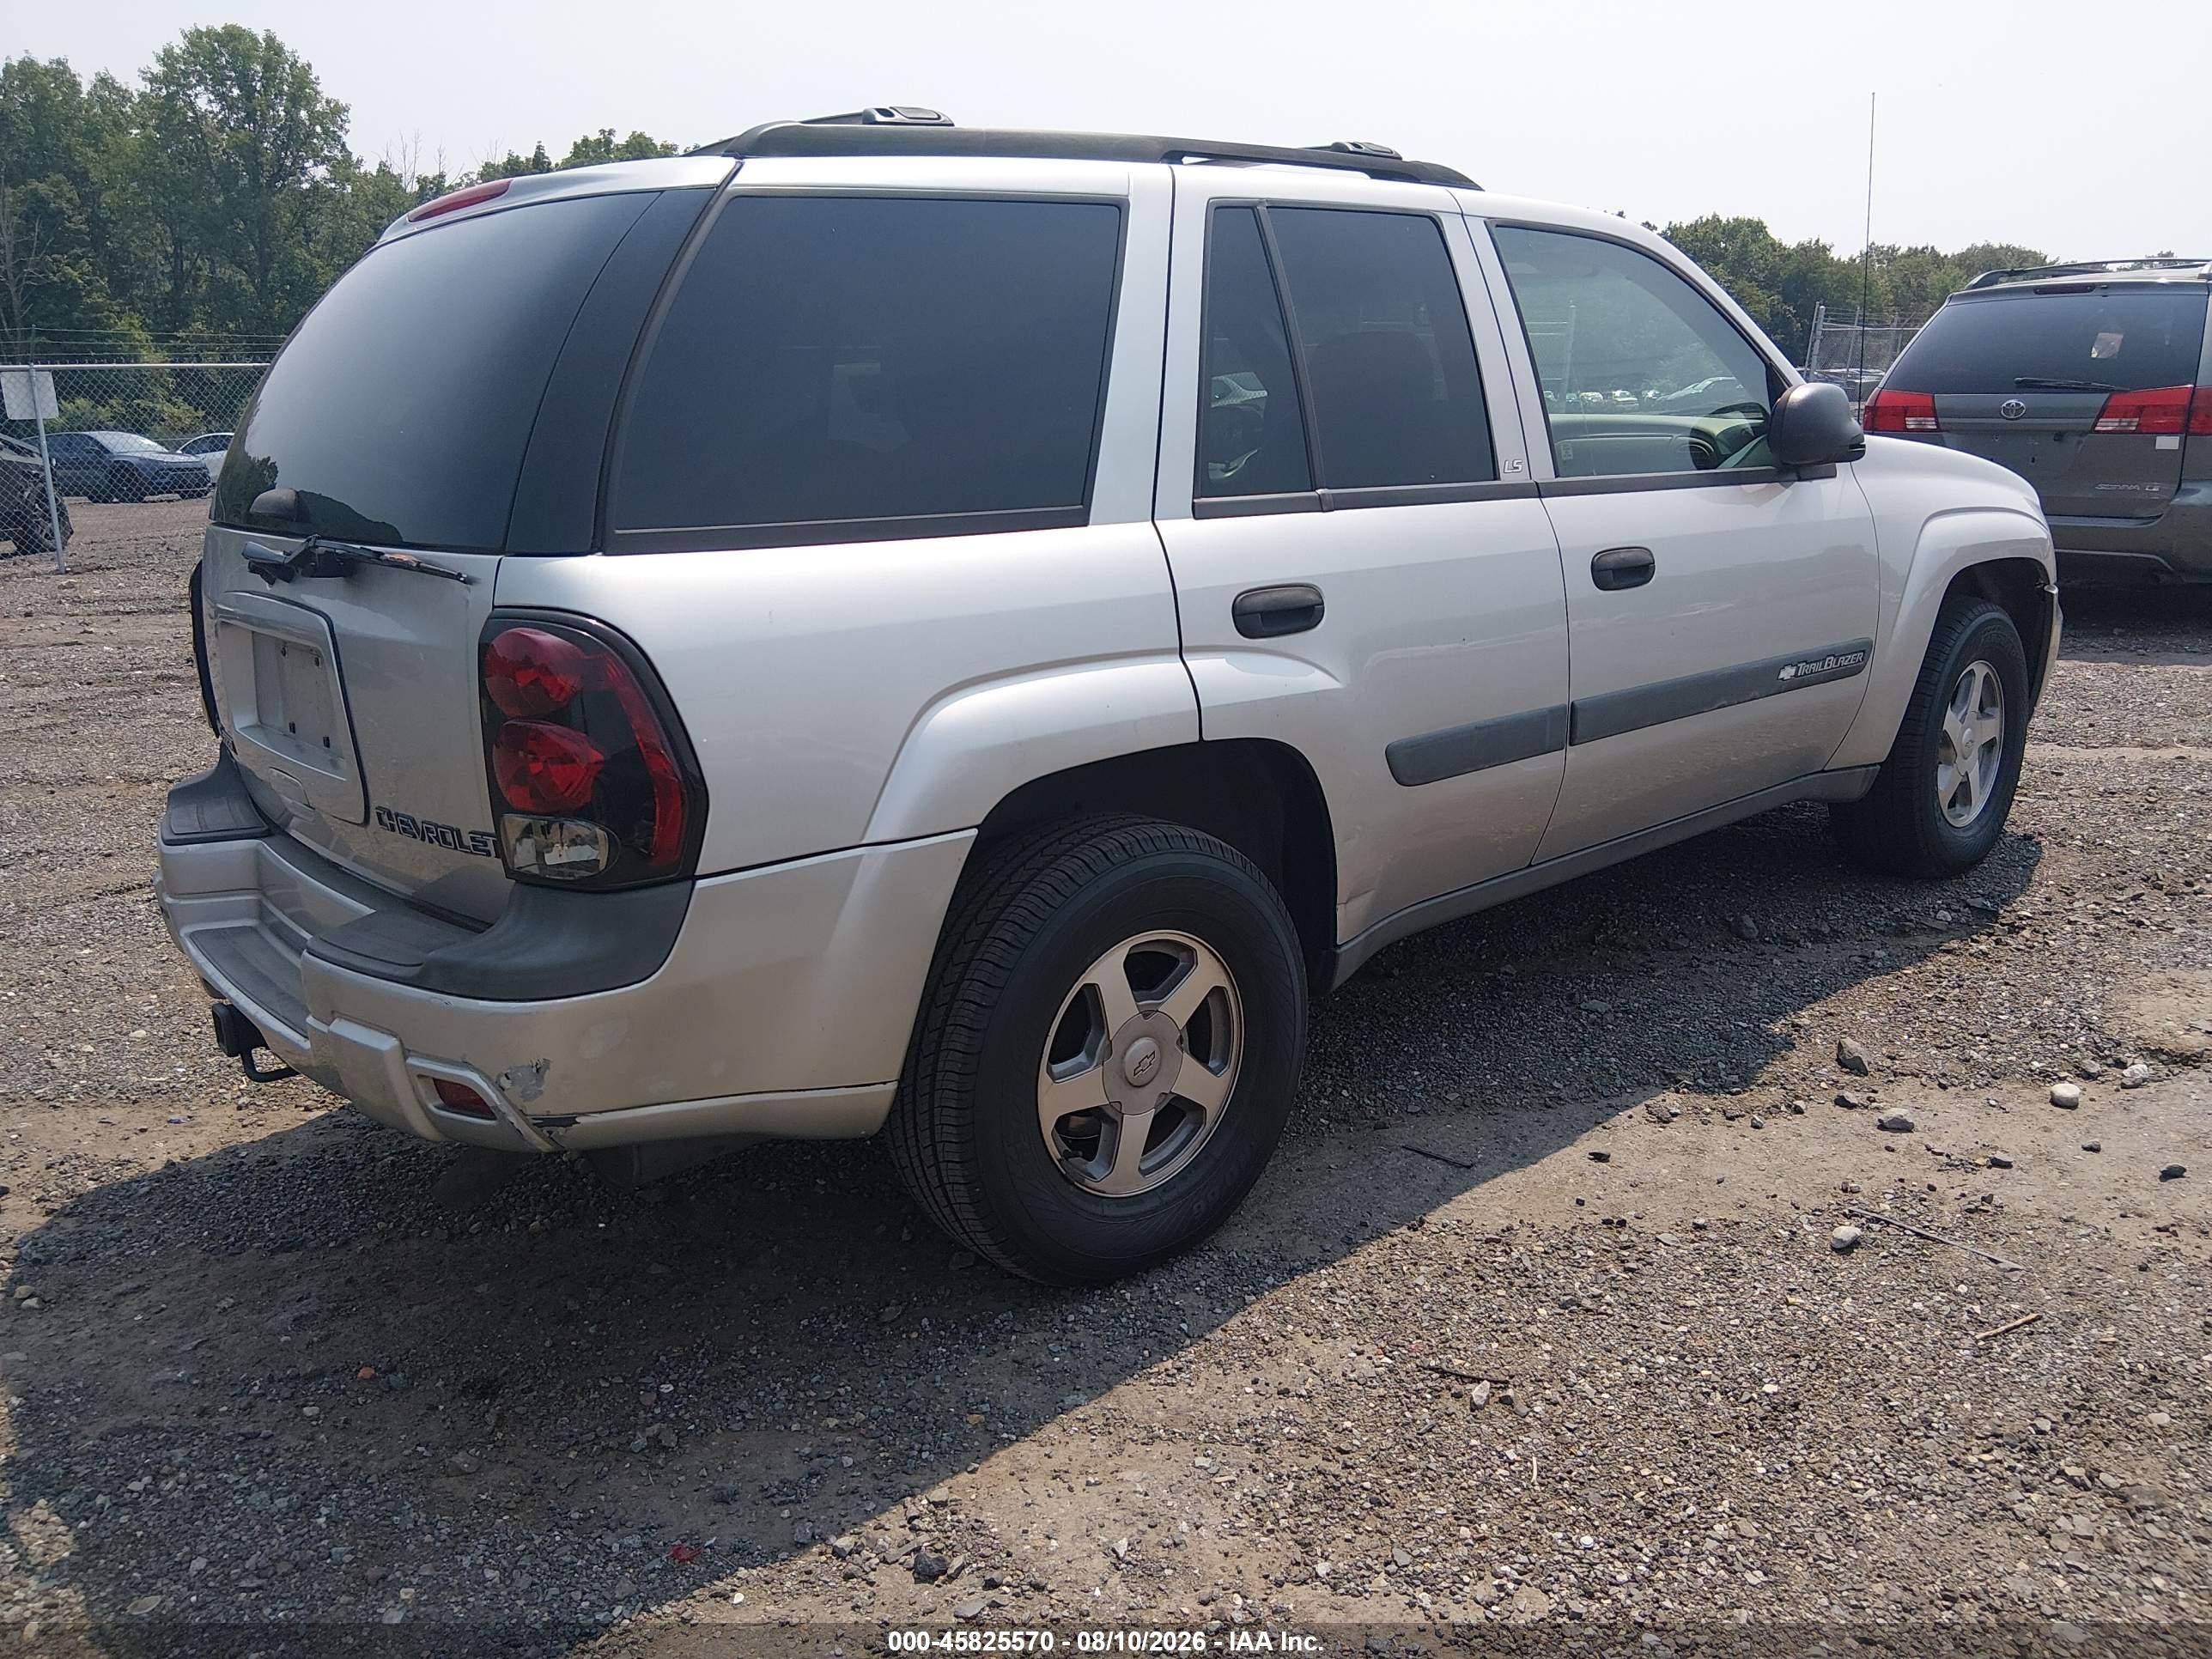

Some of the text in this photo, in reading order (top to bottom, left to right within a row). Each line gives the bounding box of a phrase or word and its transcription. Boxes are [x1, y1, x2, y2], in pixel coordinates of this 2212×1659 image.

[1504, 459, 1522, 473] LS
[1796, 651, 1865, 677] TRAILBLAZER
[375, 805, 499, 858] CHEVROLET
